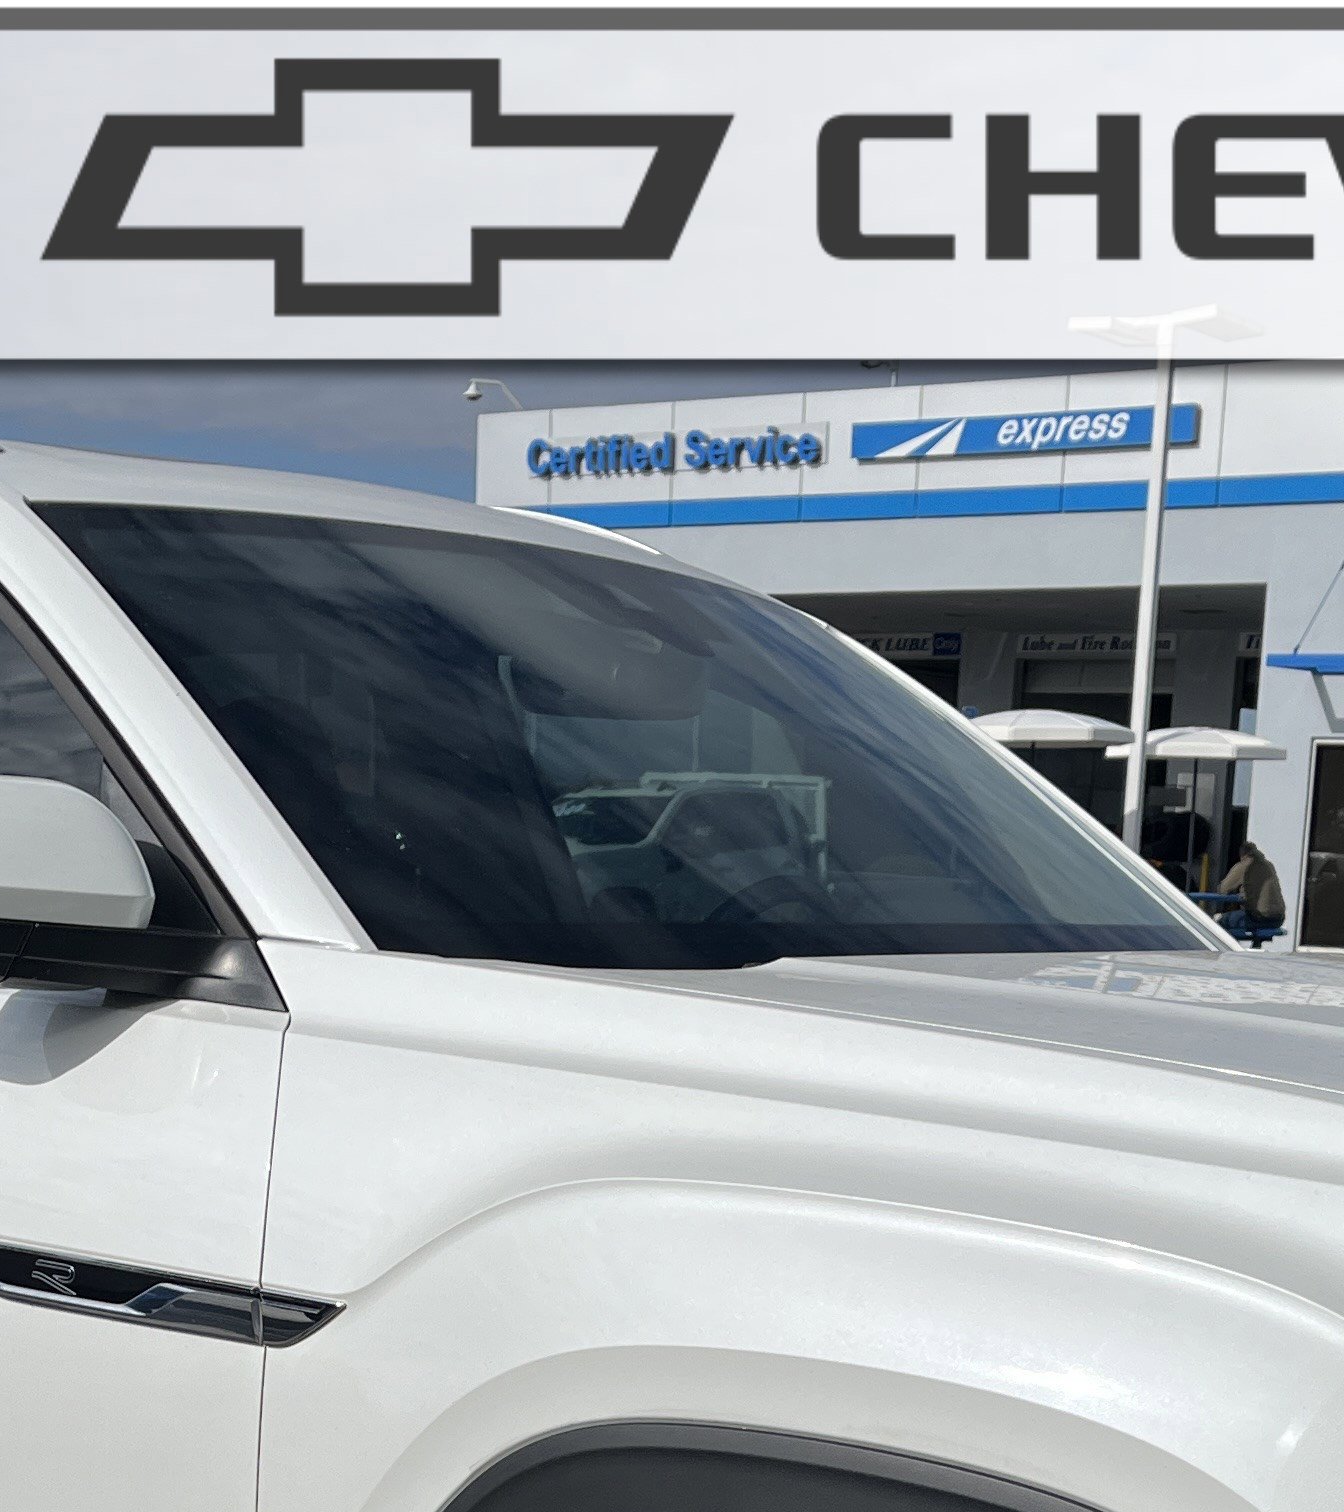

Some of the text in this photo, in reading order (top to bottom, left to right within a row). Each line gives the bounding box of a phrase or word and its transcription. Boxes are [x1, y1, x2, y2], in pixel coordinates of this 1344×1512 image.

[995, 409, 1130, 448] express
[526, 430, 822, 478] Certified Service
